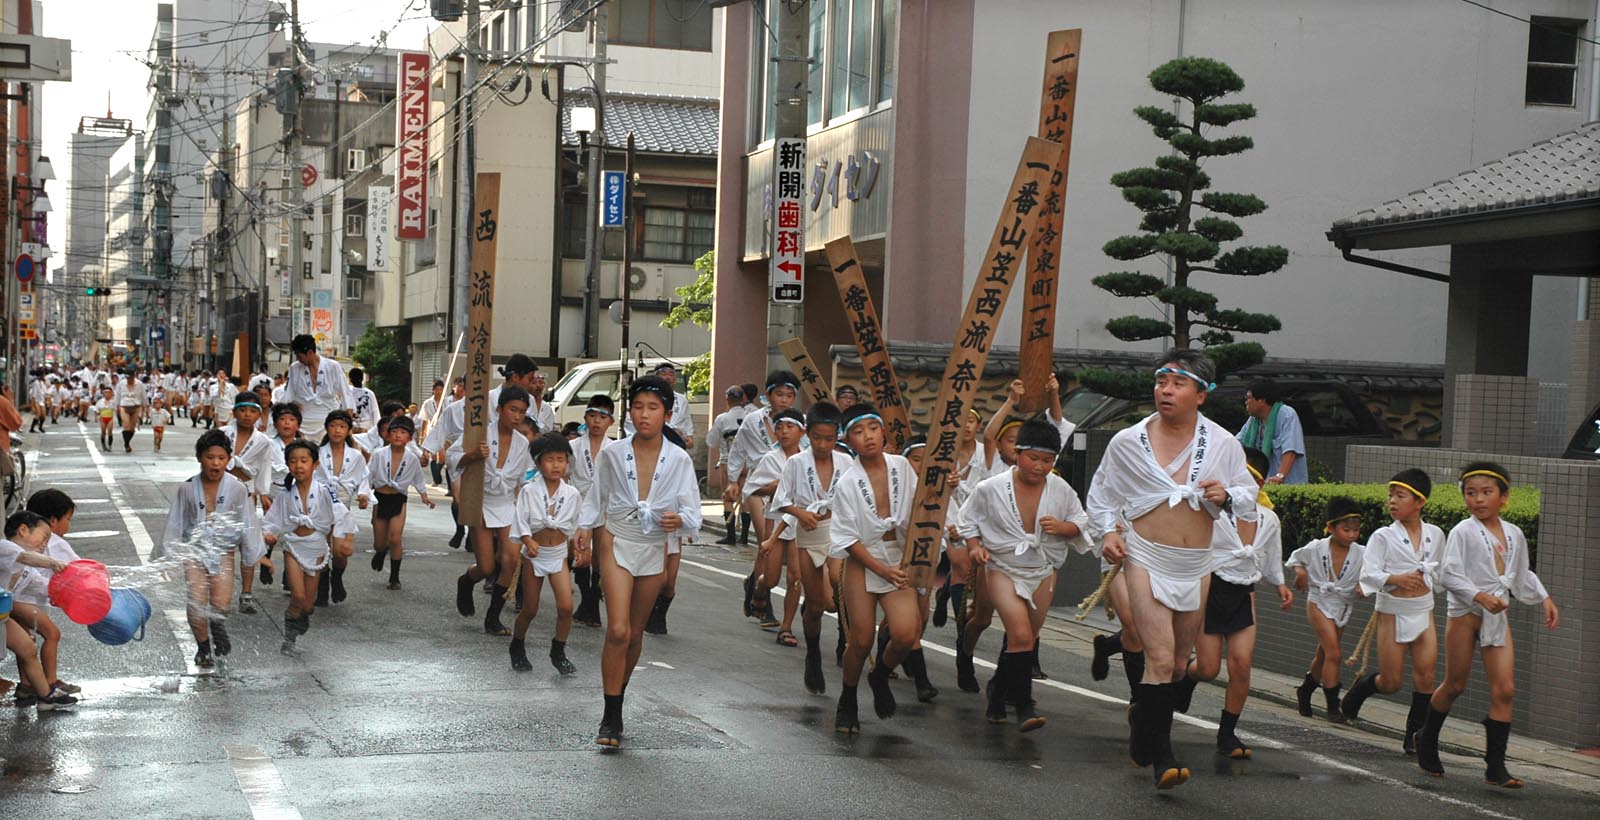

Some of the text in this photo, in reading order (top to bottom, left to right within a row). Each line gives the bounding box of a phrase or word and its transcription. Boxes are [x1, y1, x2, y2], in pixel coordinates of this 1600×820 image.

[402, 61, 426, 231] RAIMENT
[777, 141, 802, 257] 新開歯科
[791, 354, 828, 400] 一番山
[910, 161, 1050, 569] 一番山笠西流奈良屋町二区
